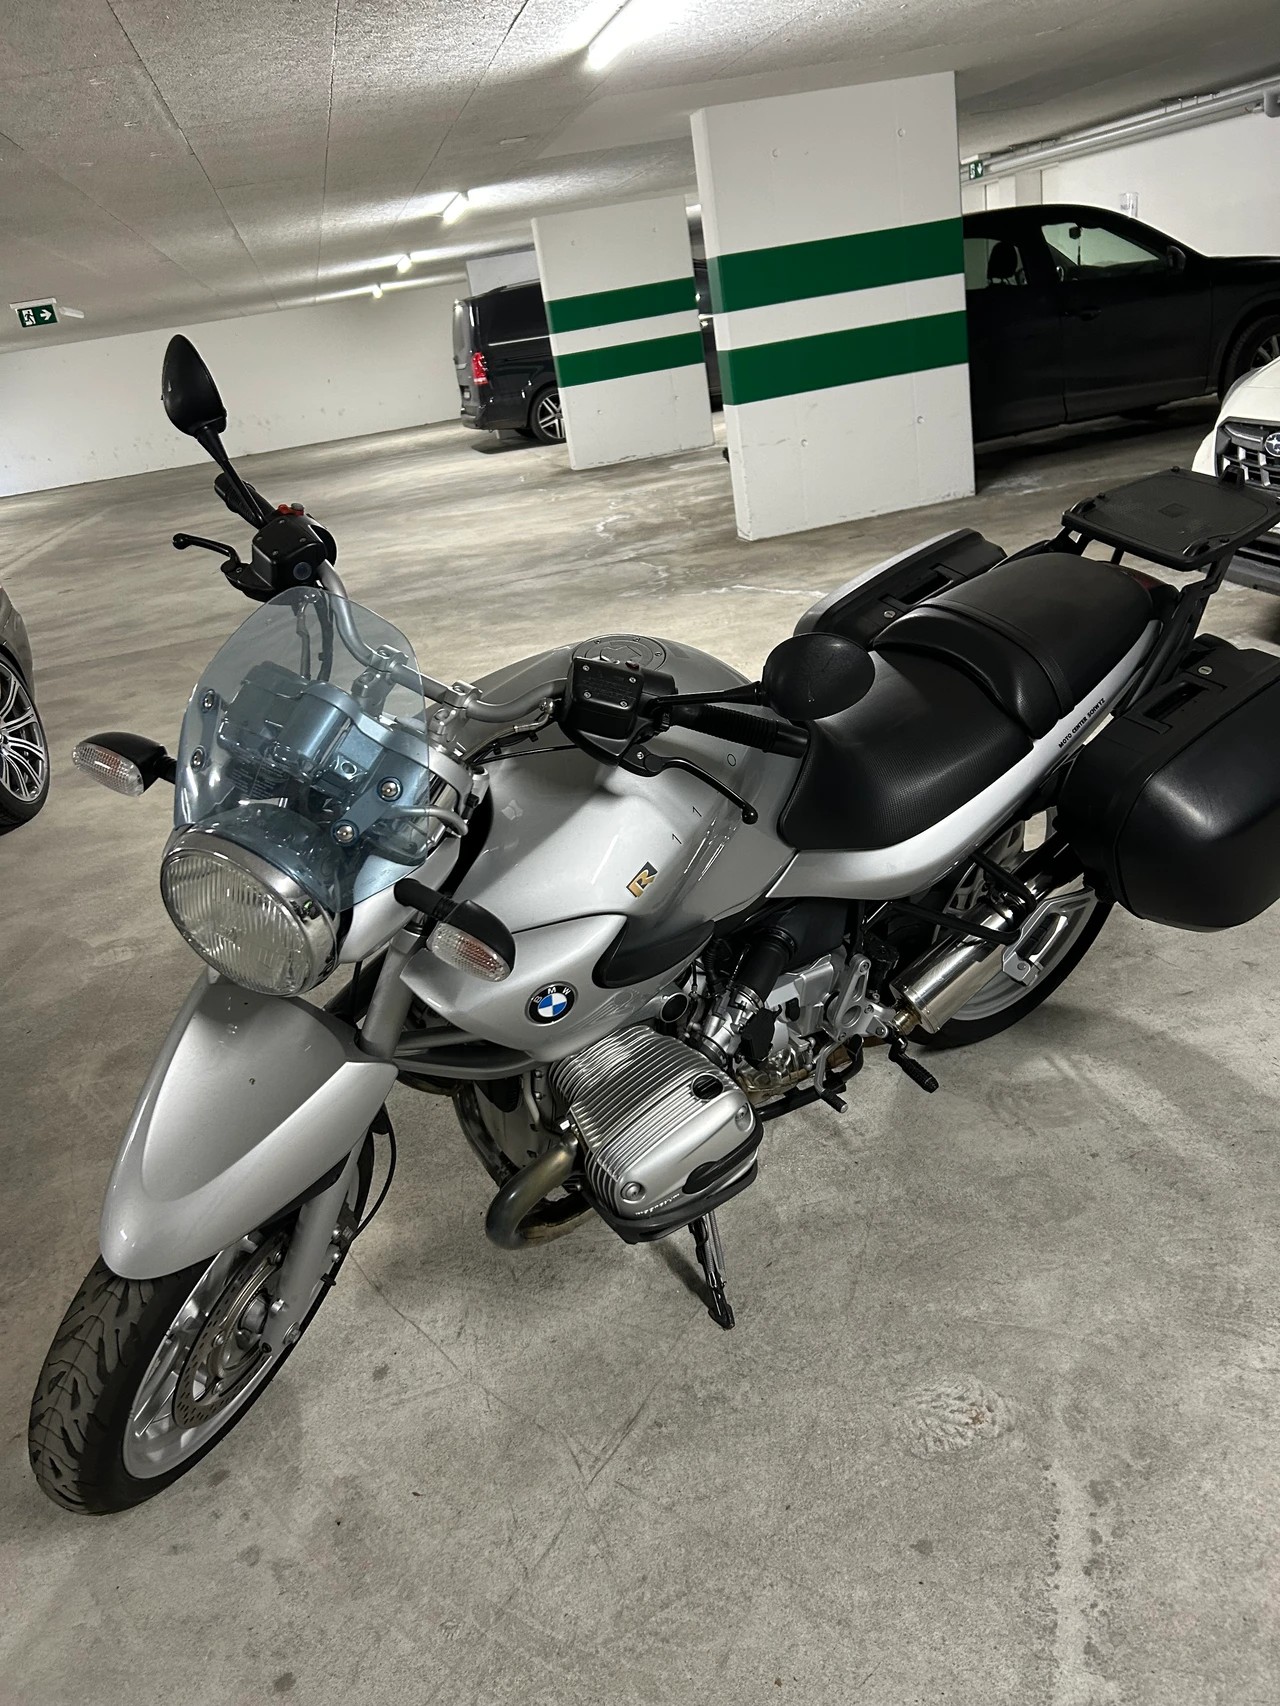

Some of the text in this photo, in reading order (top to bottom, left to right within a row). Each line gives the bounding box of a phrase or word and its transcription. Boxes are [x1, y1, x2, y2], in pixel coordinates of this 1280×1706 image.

[1058, 733, 1073, 748] MOTO
[1071, 716, 1088, 734] CENTER
[533, 986, 572, 1004] BMW
